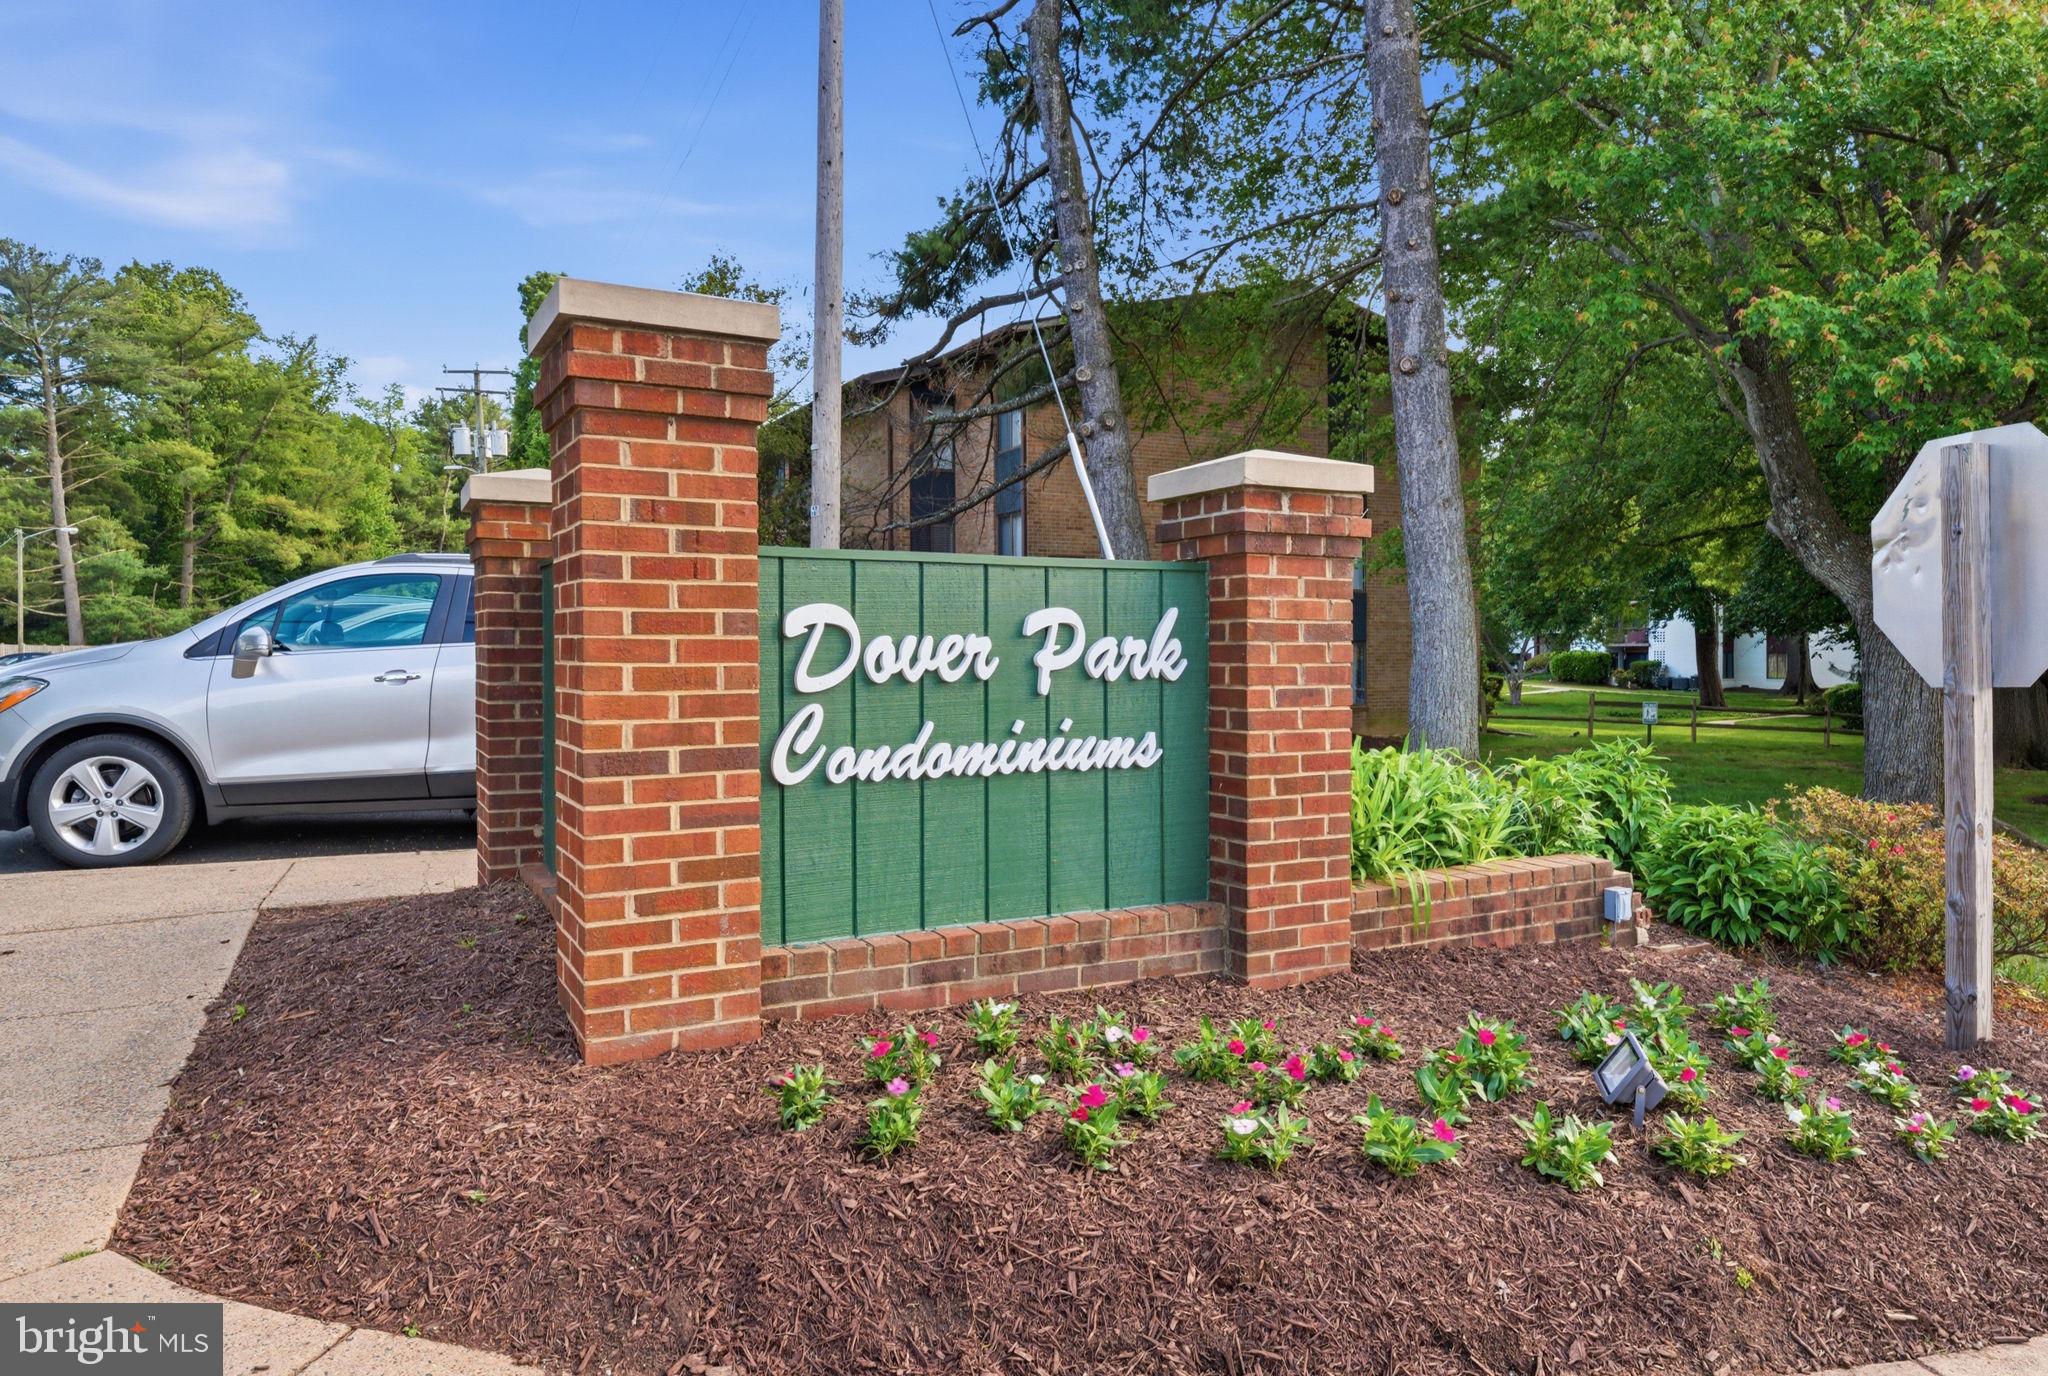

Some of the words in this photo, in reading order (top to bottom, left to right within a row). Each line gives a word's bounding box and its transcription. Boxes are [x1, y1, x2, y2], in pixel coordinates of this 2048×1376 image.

[783, 602, 1000, 694] Dover
[1022, 606, 1188, 697] Park
[771, 702, 1163, 787] Condominiums
